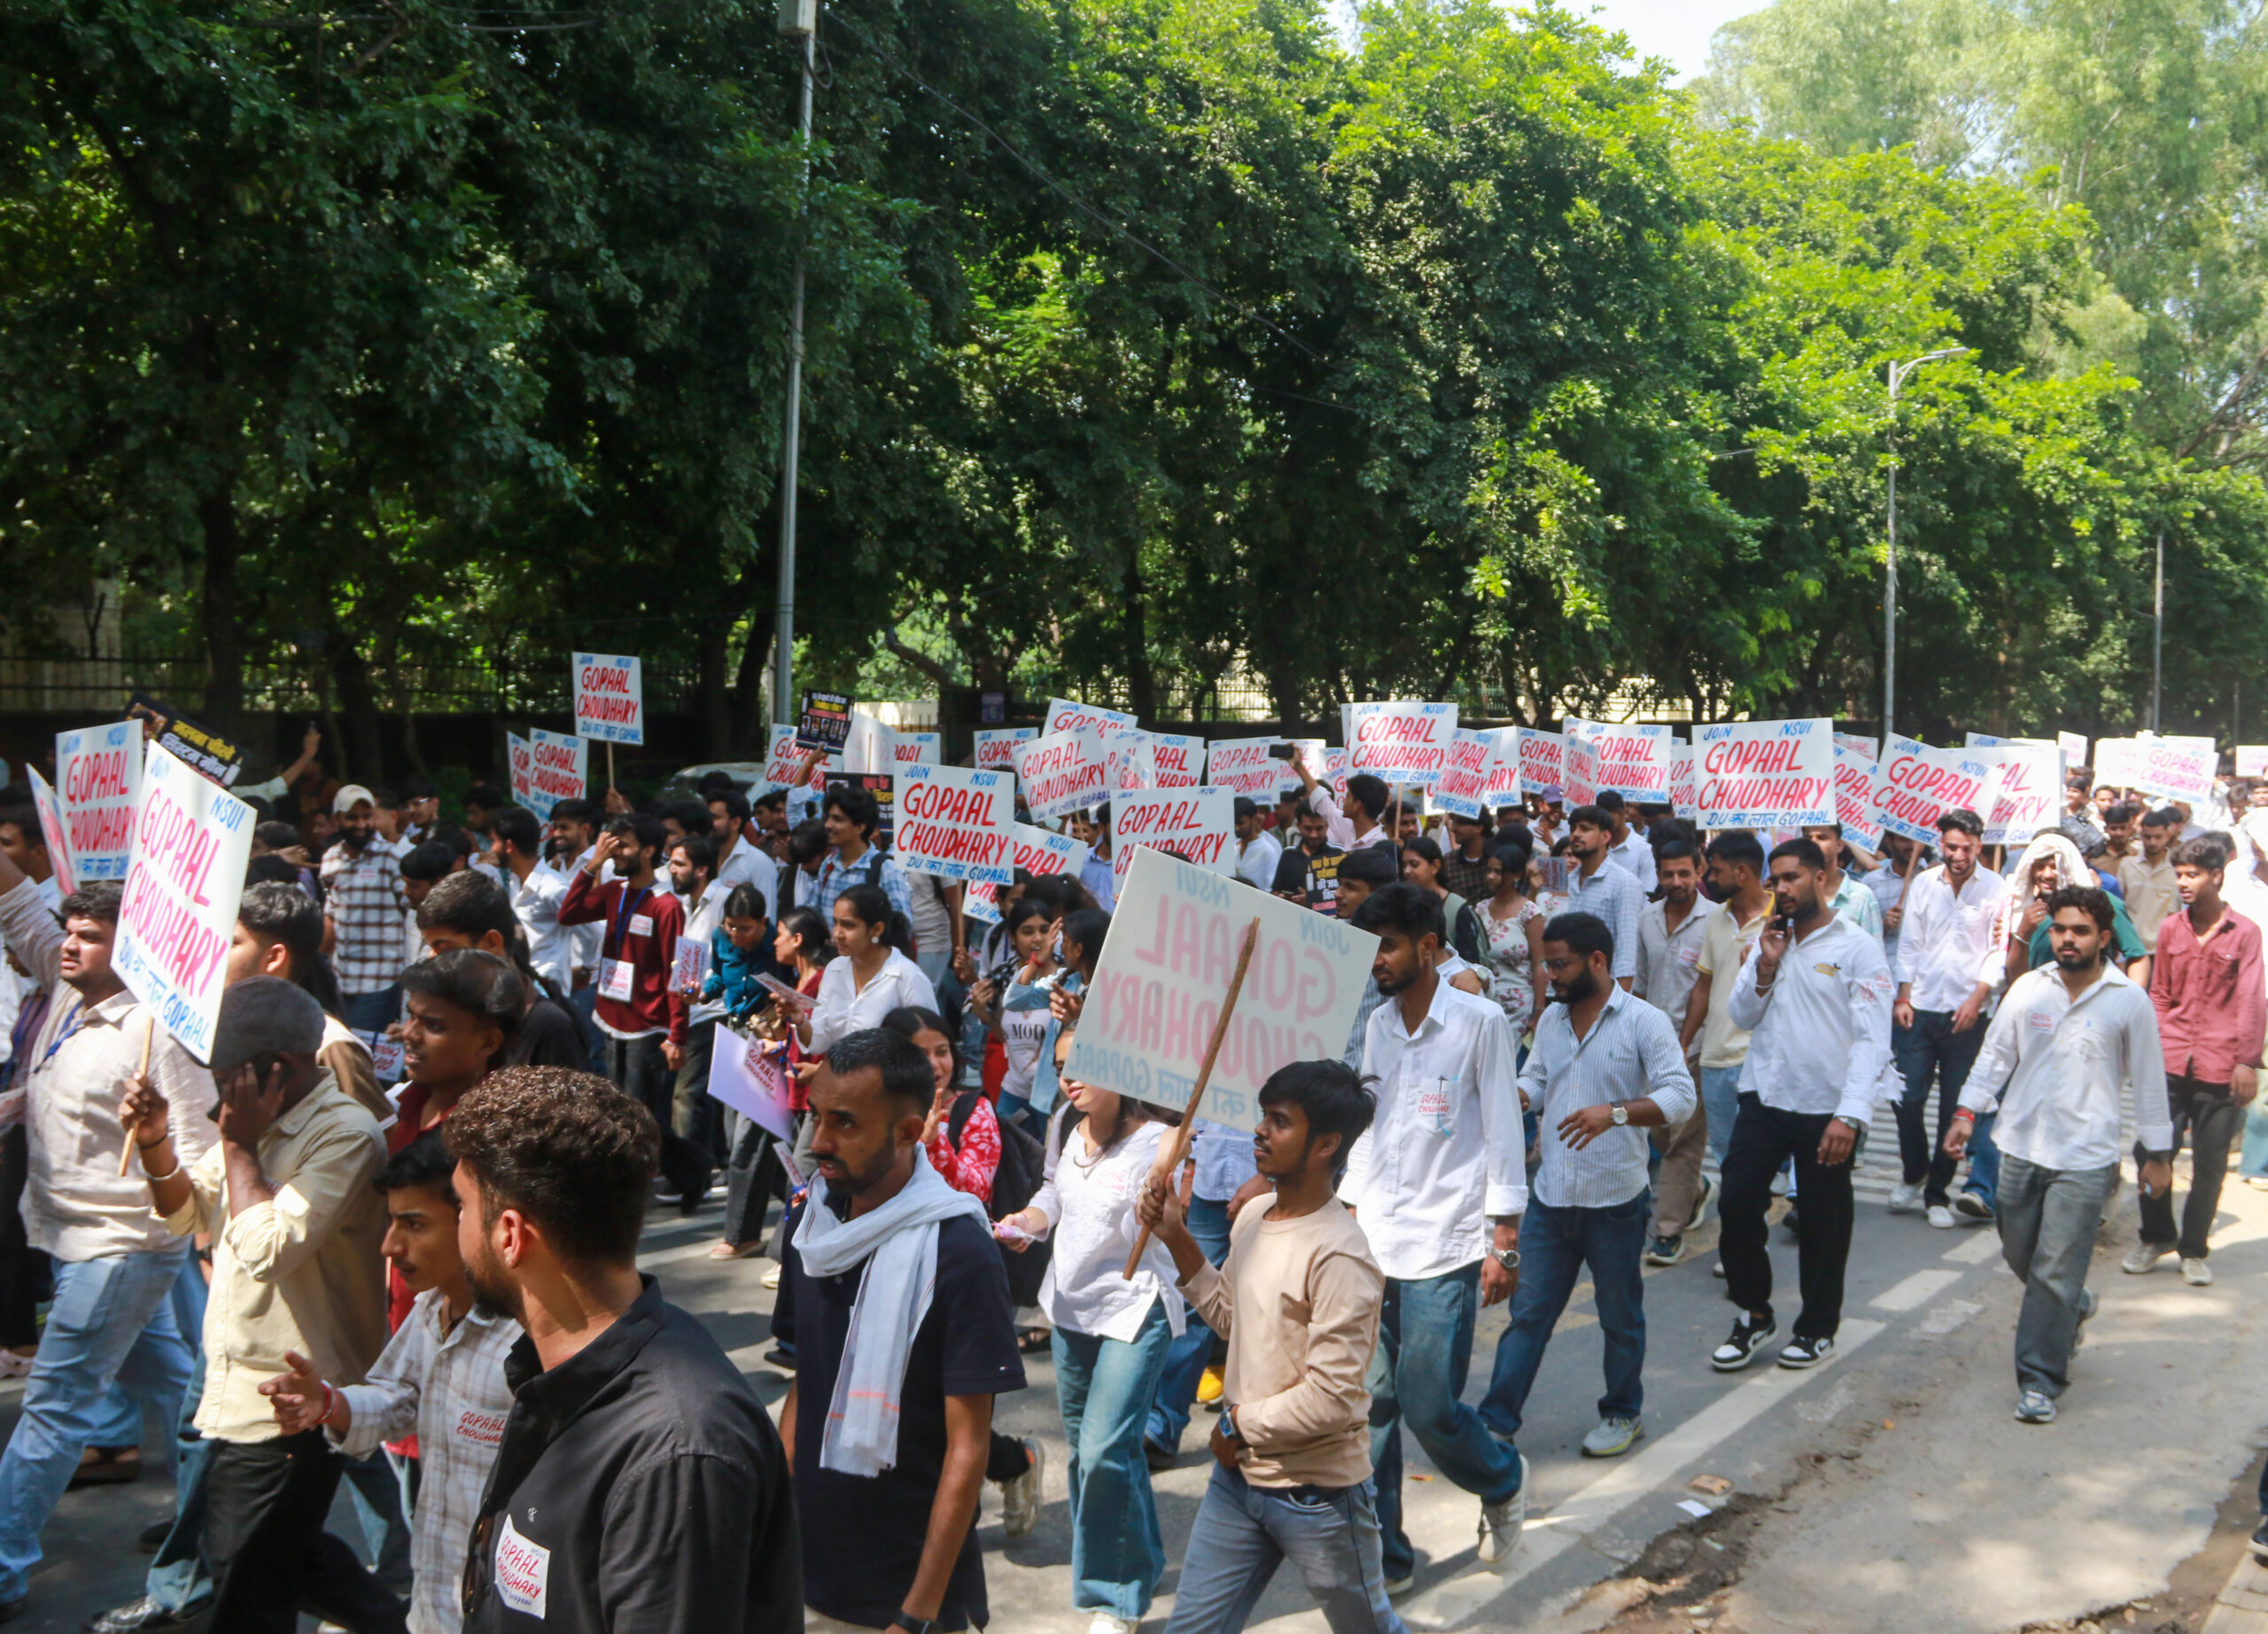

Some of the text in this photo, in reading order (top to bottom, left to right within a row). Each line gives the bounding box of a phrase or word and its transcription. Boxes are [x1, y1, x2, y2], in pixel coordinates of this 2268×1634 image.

[581, 666, 630, 694] GOPAAL
[577, 695, 639, 724] CHOUDHARY
[1358, 704, 1449, 715] JOIN NSUI
[1357, 716, 1436, 743] GOPAAL
[1704, 721, 1814, 741] JOIN NSUI
[534, 742, 578, 774] GOPAAL
[1021, 740, 1087, 779] GOPAAL
[1210, 746, 1268, 772] GOPAAL
[1446, 741, 1489, 773] GOPAAL
[1705, 739, 1804, 774] GOPAAL
[1894, 739, 1990, 777] JOIN NSUI
[2148, 750, 2207, 776] GOPAAL
[66, 751, 128, 806] GOPAAL
[905, 765, 999, 786] JOIN NSUI
[1029, 761, 1105, 807] CHOUDHARY
[1889, 756, 1982, 812] GOPAAL
[2140, 766, 2210, 794] CHOUDHARY
[904, 782, 997, 827] GOPAAL
[1698, 777, 1830, 811] CHOUDHARY
[210, 793, 246, 833] NSUI
[1117, 800, 1203, 835] GOPAAL
[1706, 810, 1831, 827] DU का लाल GOPAAL
[1877, 813, 1896, 827] DU
[141, 787, 221, 908] GOPAAL
[897, 820, 1009, 866] CHOUDHARY
[1045, 835, 1075, 852] NSUI
[906, 856, 1012, 883] DU का लाल GOPAAL
[970, 902, 984, 915] DU
[122, 860, 228, 998] CHOUDHARY
[163, 992, 206, 1051] GOPAAL
[748, 1048, 774, 1083] GOPAAL
[461, 1411, 507, 1432] GOPAAL
[501, 1535, 540, 1578] GOPAAL
